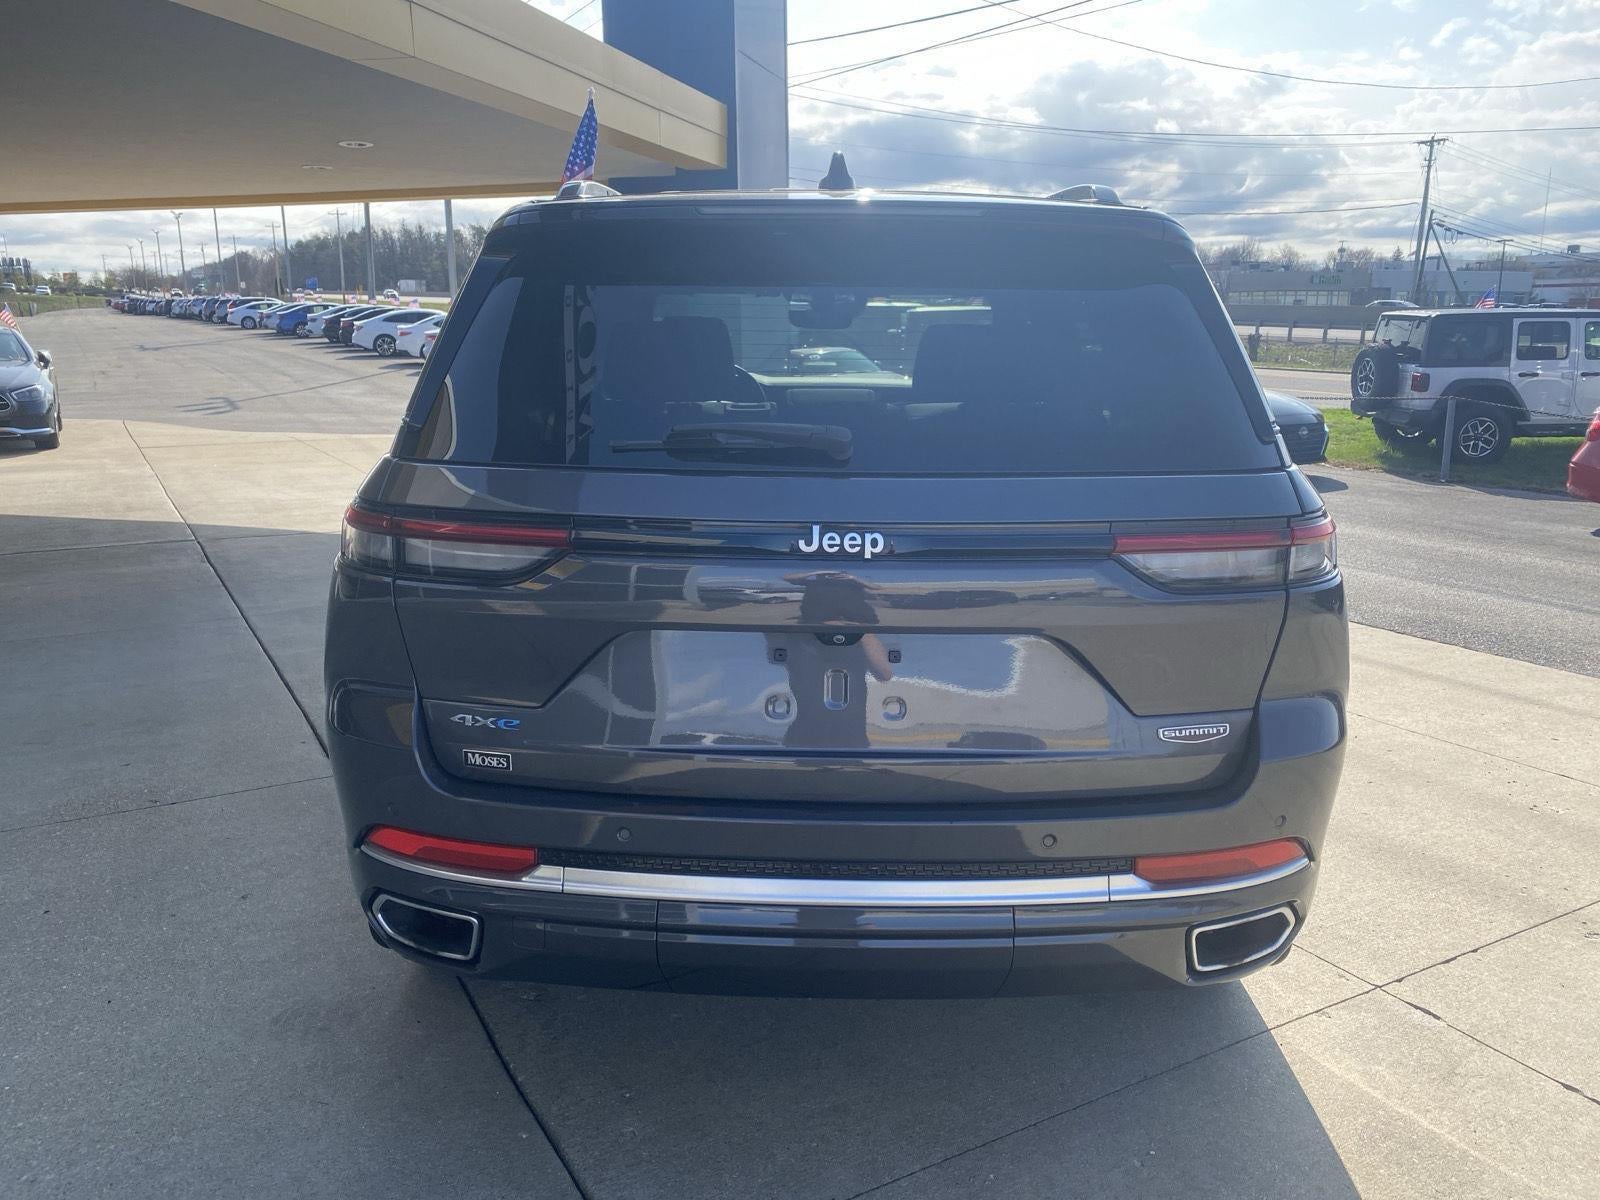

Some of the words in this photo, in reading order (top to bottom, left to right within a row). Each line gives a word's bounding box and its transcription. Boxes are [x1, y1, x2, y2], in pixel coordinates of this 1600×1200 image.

[798, 525, 884, 559] Jeep
[1163, 726, 1227, 738] SUMMIT
[467, 752, 507, 768] MOSES
